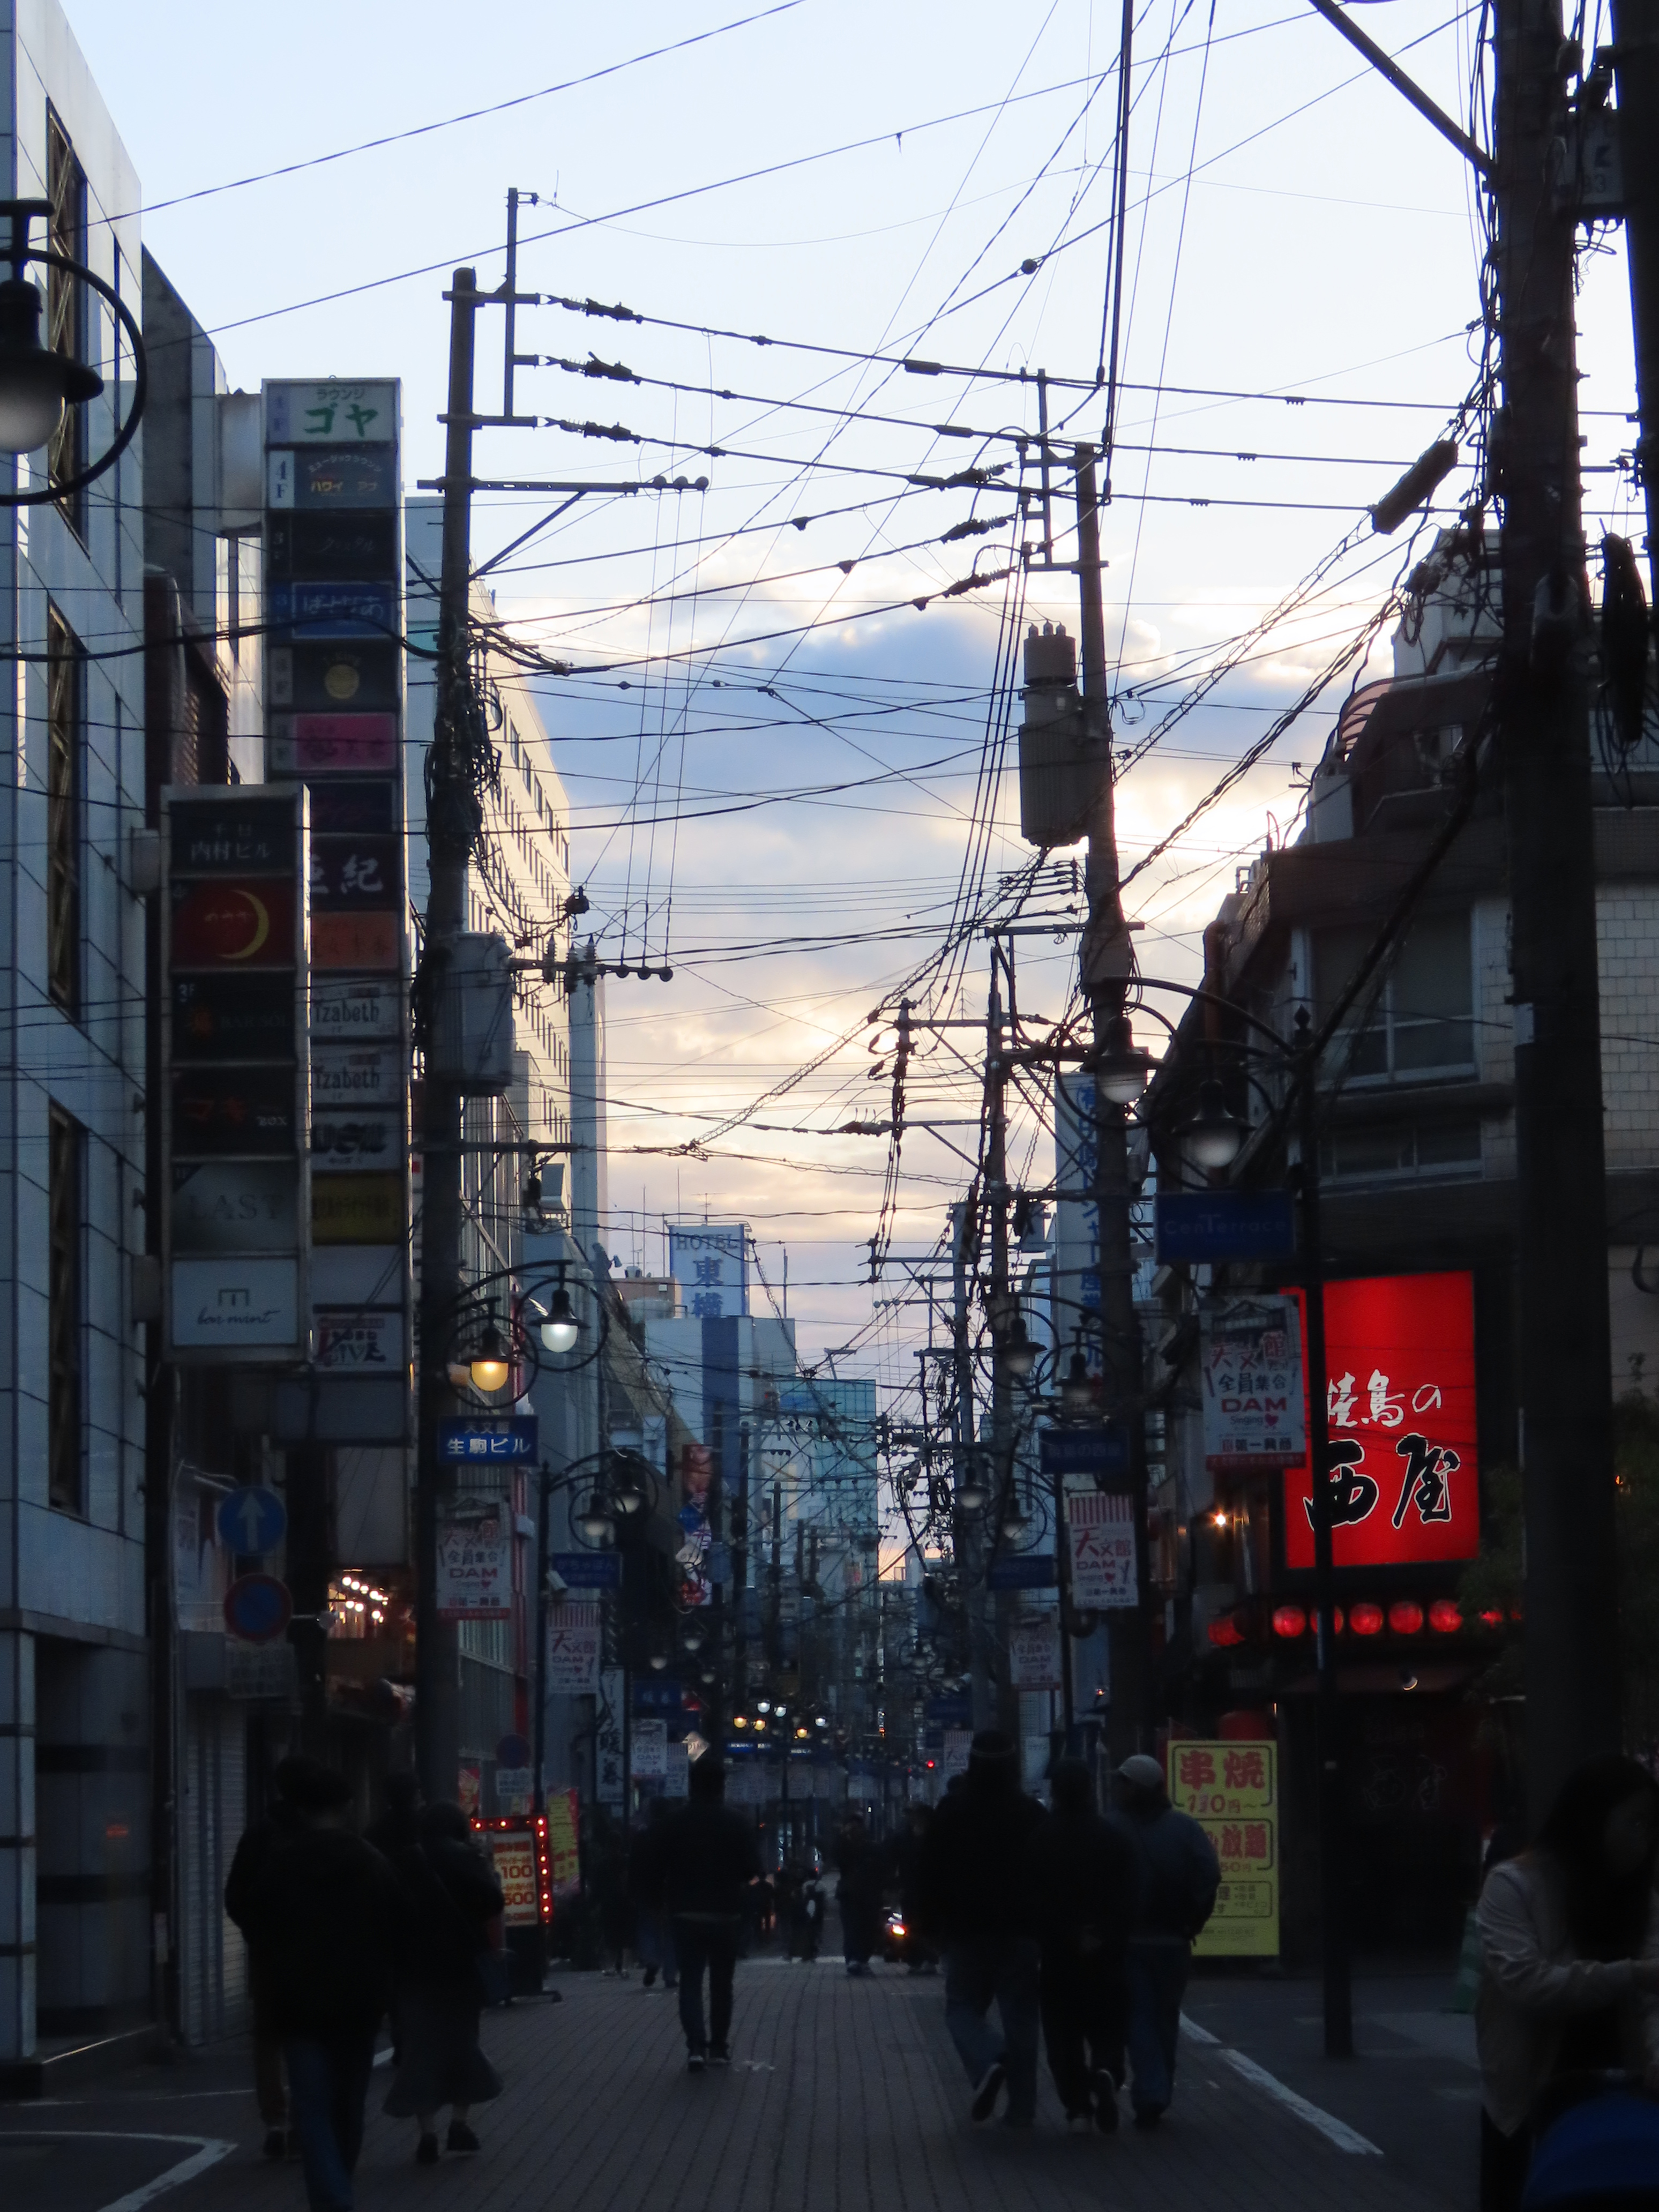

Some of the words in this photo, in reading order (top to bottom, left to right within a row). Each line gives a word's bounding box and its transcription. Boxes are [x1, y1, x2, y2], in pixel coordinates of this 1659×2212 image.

[317, 388, 365, 401] ラウンジ
[303, 402, 379, 438] ゴヤ
[676, 1234, 739, 1251] HOTEL
[1218, 1372, 1287, 1395] 全員集合
[1221, 1396, 1287, 1414] DAM
[446, 1437, 532, 1454] 生駒ビル
[449, 1567, 498, 1579] DAM
[1076, 1560, 1116, 1571] DAM
[1179, 1750, 1266, 1791] 串焼
[502, 1865, 533, 1879] 100
